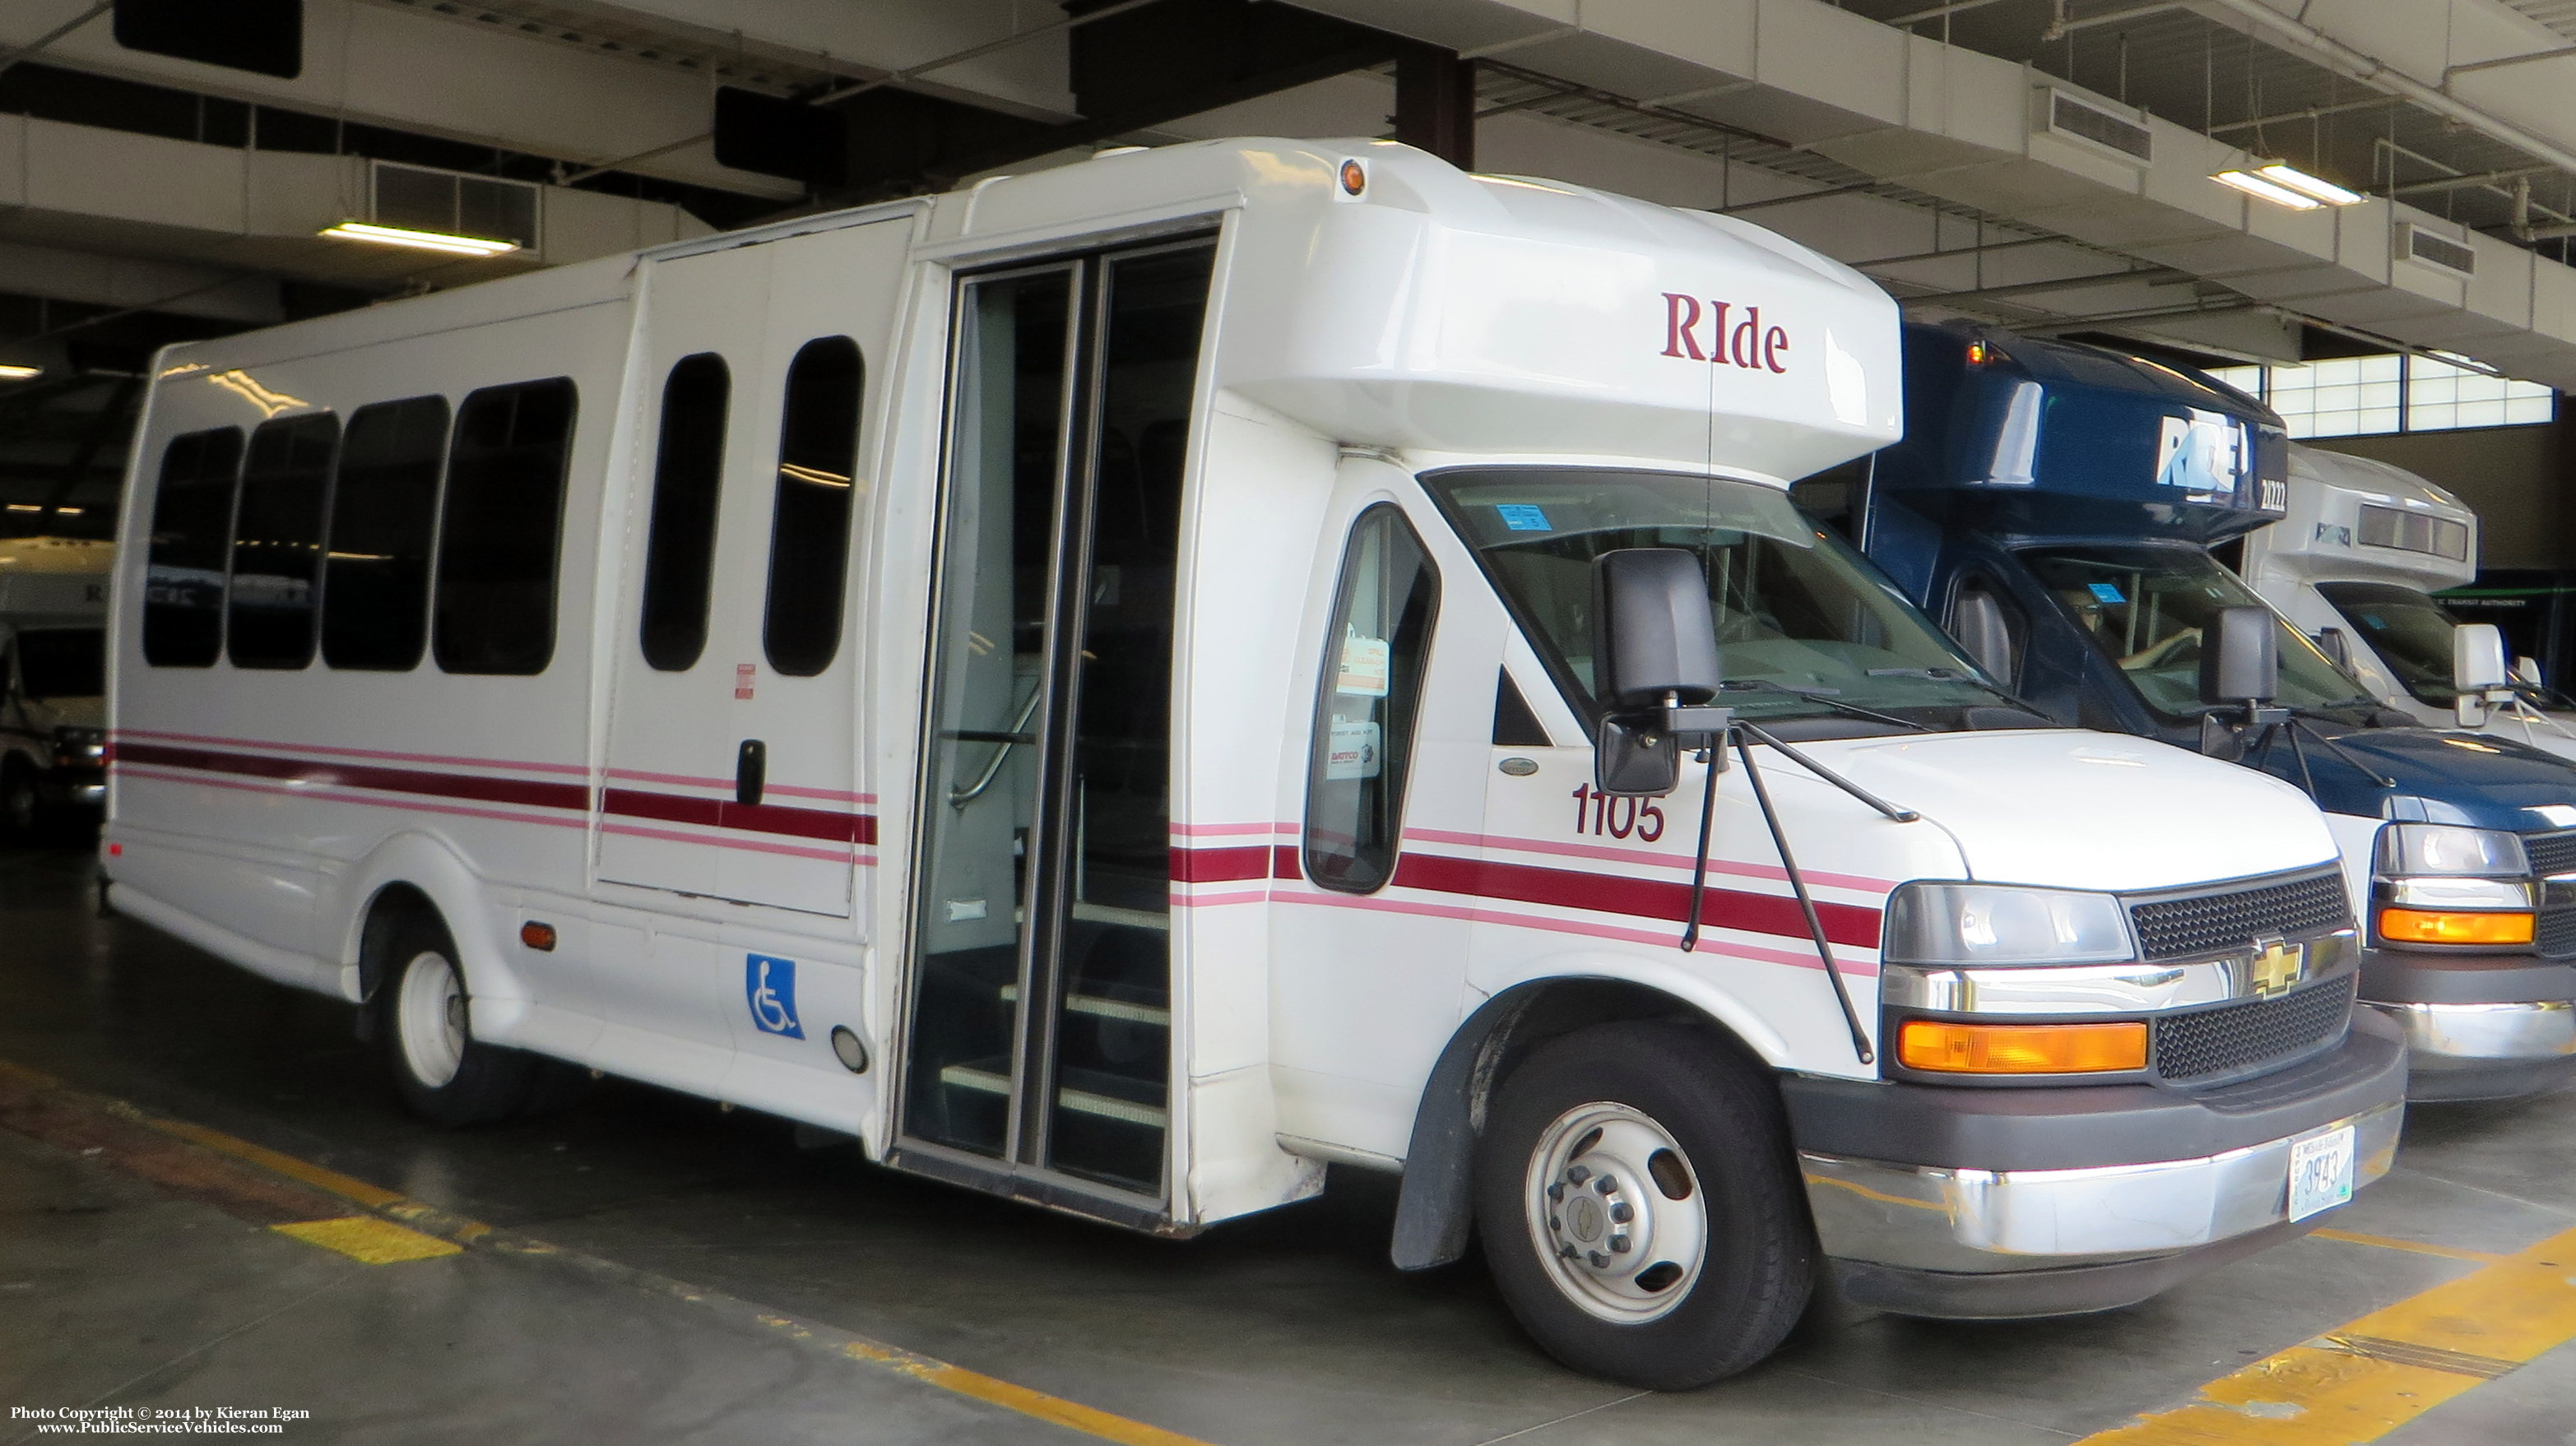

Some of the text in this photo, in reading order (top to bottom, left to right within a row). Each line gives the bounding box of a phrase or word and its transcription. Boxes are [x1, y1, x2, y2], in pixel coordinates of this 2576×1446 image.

[1660, 292, 1789, 373] RIde
[1572, 783, 1665, 842] 1105
[2304, 1150, 2338, 1195] 3943
